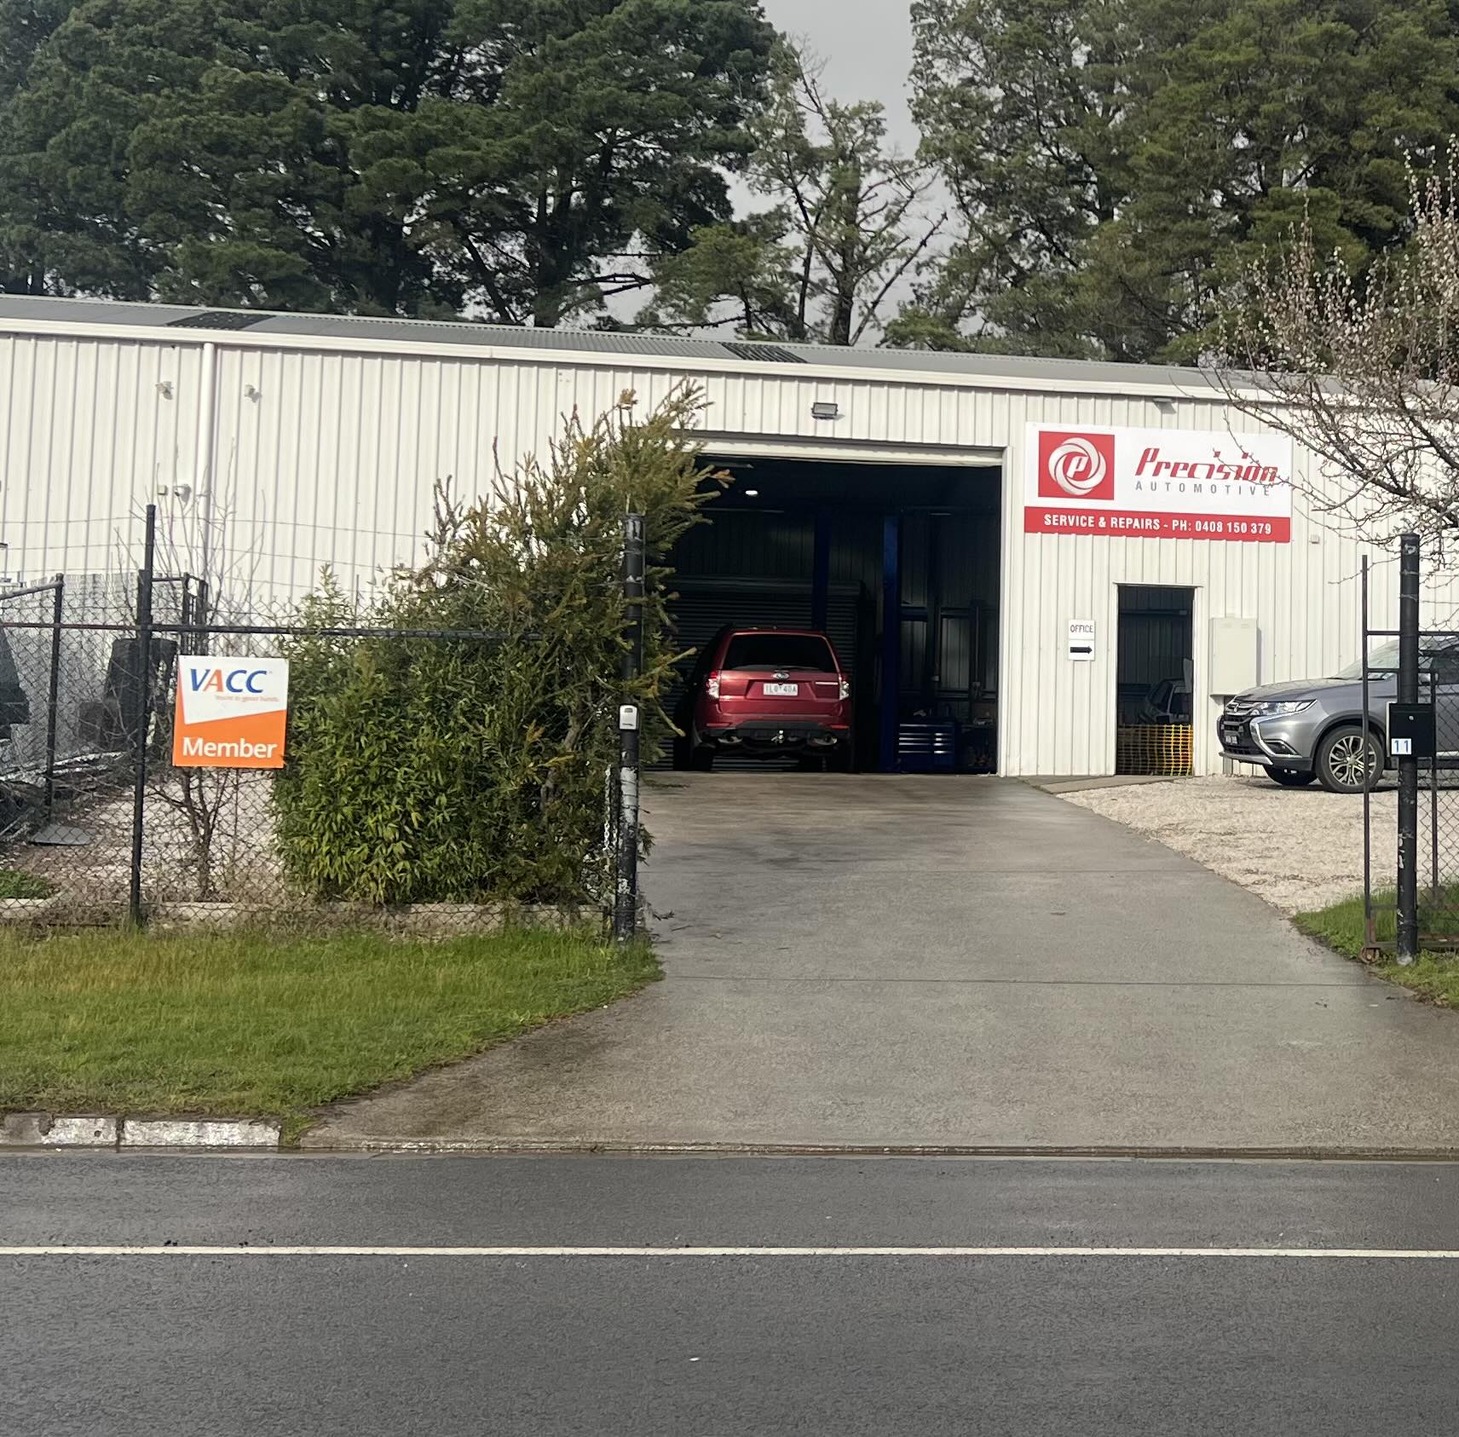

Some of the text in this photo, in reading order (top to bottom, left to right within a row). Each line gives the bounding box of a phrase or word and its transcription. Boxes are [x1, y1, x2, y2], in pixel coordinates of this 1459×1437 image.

[1135, 480, 1270, 497] AUTOMOTIVE
[1044, 513, 1095, 527] SERVICE
[1099, 517, 1106, 527] &
[1110, 516, 1160, 530] REPAIRS
[1172, 519, 1191, 531] PH:
[1195, 520, 1223, 533] 0408
[1226, 521, 1247, 533] 150
[1250, 522, 1272, 535] 379
[1070, 624, 1094, 633] OFFICE
[190, 668, 267, 694] VACC
[182, 736, 278, 759] Member
[1394, 739, 1409, 753] 11
